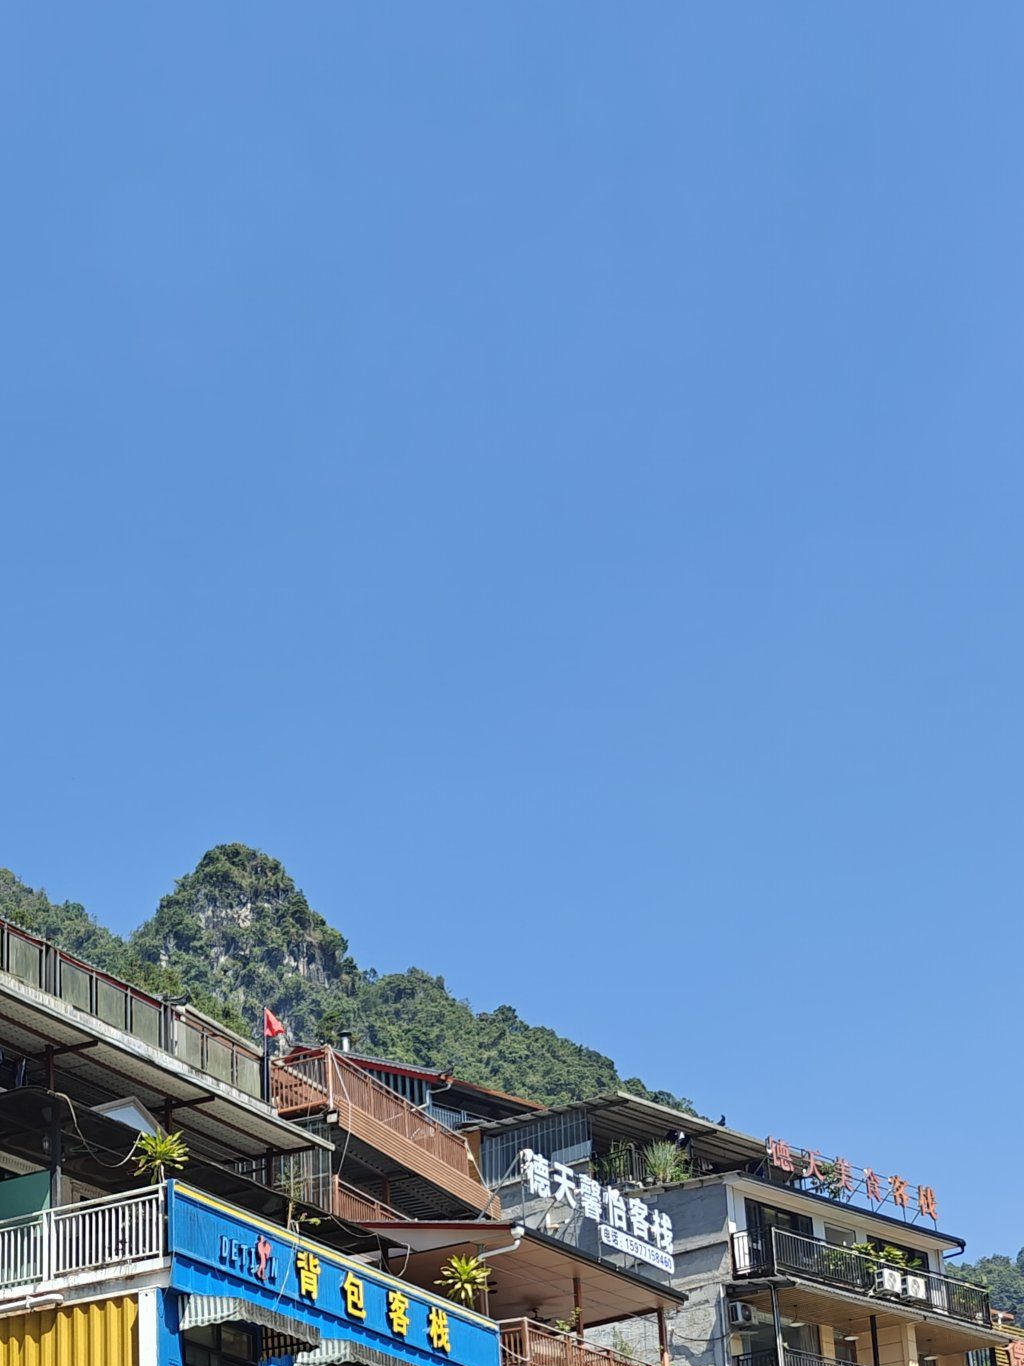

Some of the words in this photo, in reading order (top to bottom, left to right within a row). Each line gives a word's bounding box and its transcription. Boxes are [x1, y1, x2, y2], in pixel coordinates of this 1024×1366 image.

[527, 1153, 673, 1254] 德天馨怡客栈
[766, 1136, 938, 1220] 德天美食客栈
[295, 1251, 451, 1354] 背包客栈
